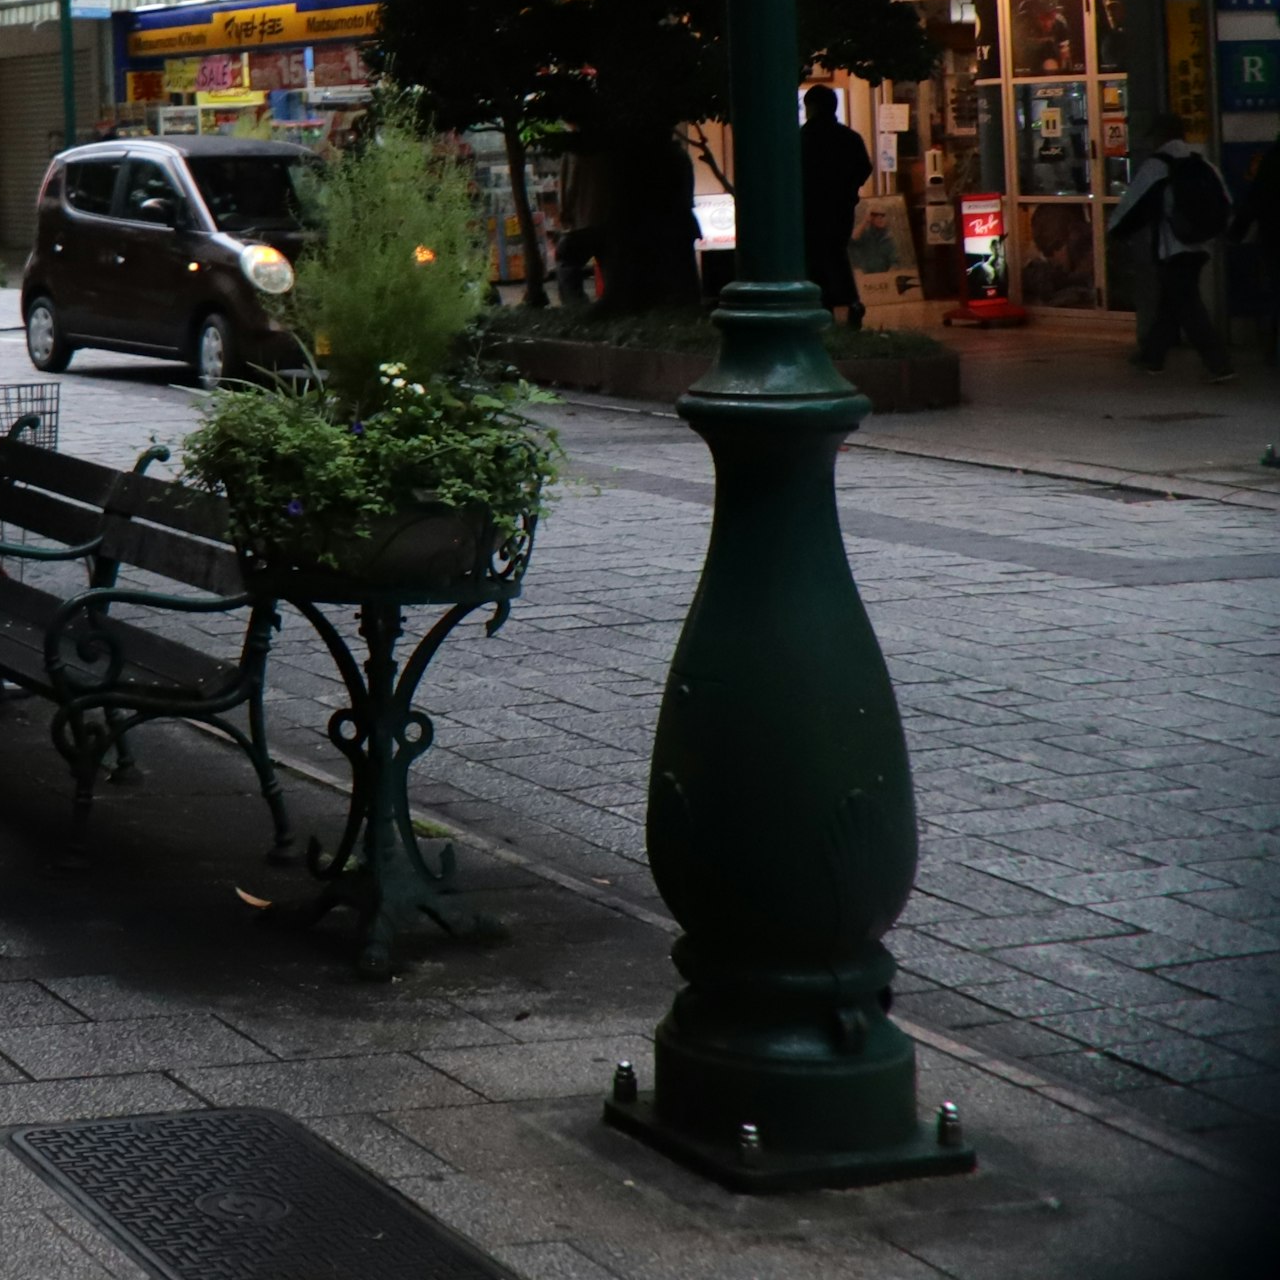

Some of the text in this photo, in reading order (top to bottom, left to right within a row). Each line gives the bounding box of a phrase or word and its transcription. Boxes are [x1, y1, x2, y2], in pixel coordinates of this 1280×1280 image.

[305, 14, 365, 33] Matsumoto
[200, 64, 229, 87] SALE
[1241, 55, 1265, 82] R
